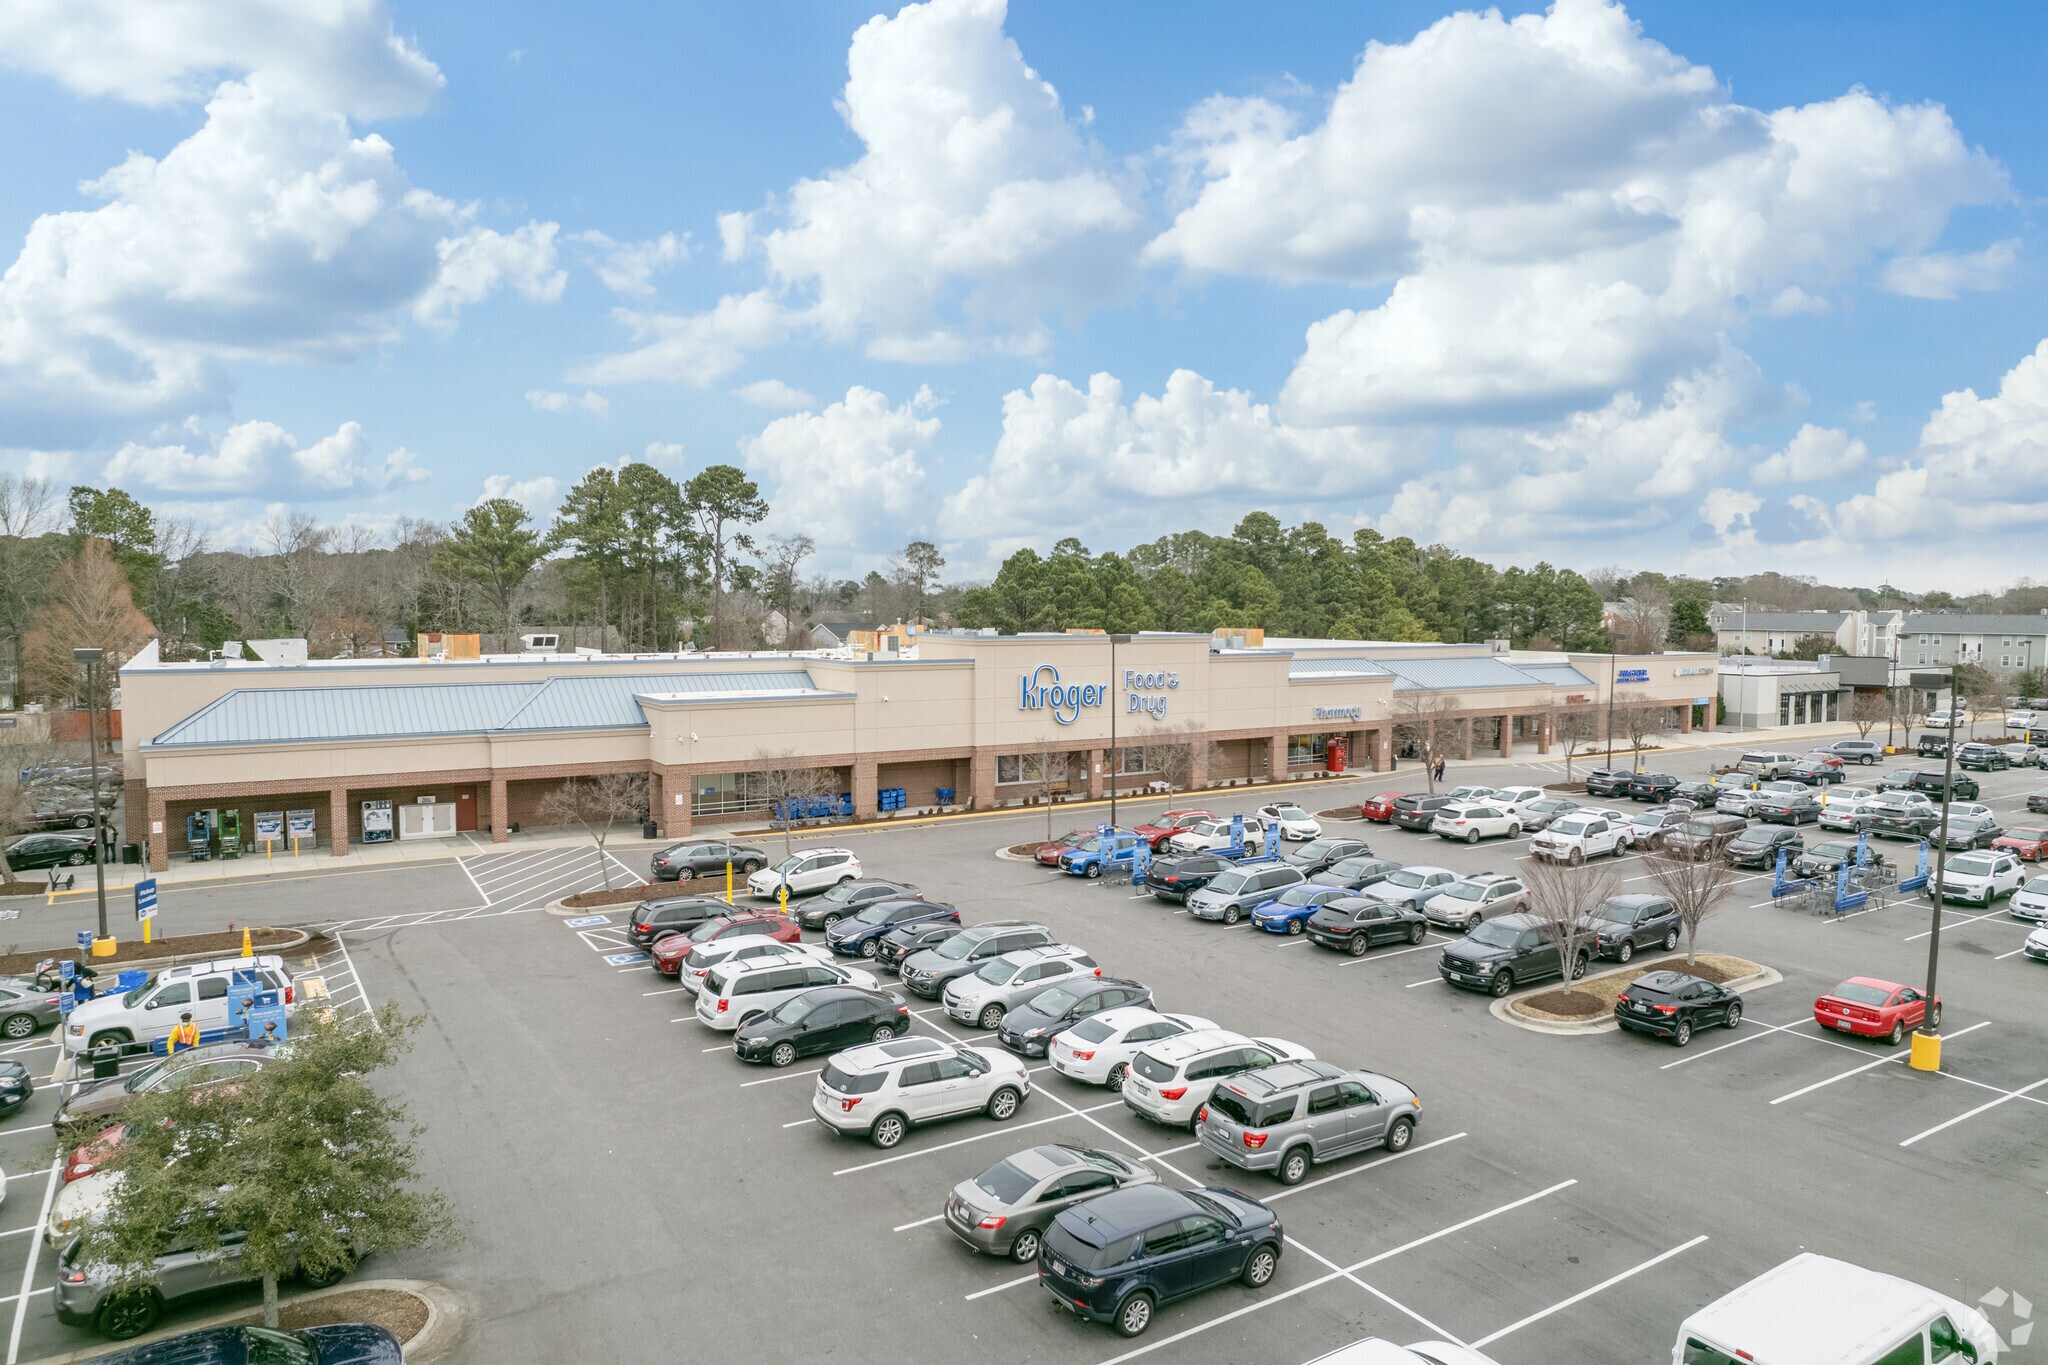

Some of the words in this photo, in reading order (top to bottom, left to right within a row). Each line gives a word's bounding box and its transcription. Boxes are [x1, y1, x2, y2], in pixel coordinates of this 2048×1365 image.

[1122, 669, 1166, 690] Food
[1019, 663, 1107, 725] Kroger
[1126, 692, 1168, 720] Drug
[1314, 706, 1362, 722] Pharmacy
[138, 894, 157, 904] Location
[140, 887, 155, 896] Pickup
